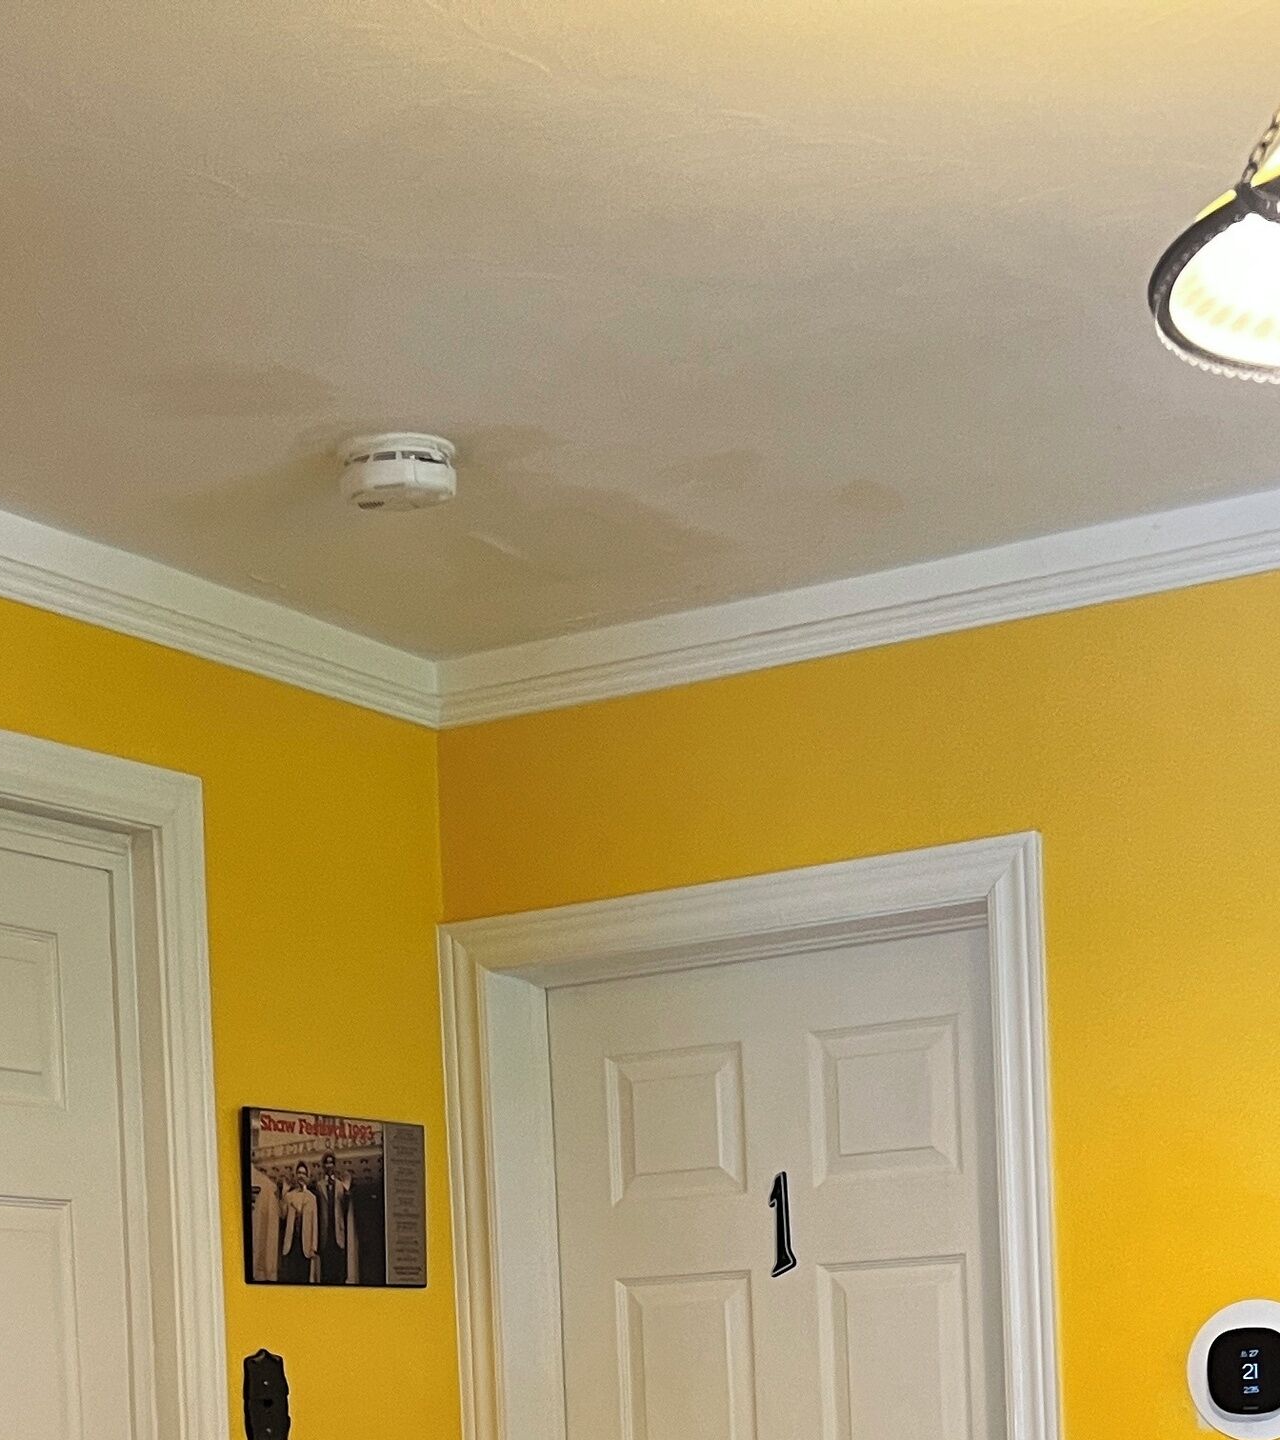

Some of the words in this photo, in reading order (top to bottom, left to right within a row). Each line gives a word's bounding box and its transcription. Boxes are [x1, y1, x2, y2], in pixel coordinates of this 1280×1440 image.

[260, 1113, 296, 1134] Shaw
[768, 1170, 798, 1278] 1
[1241, 1363, 1258, 1380] 21
